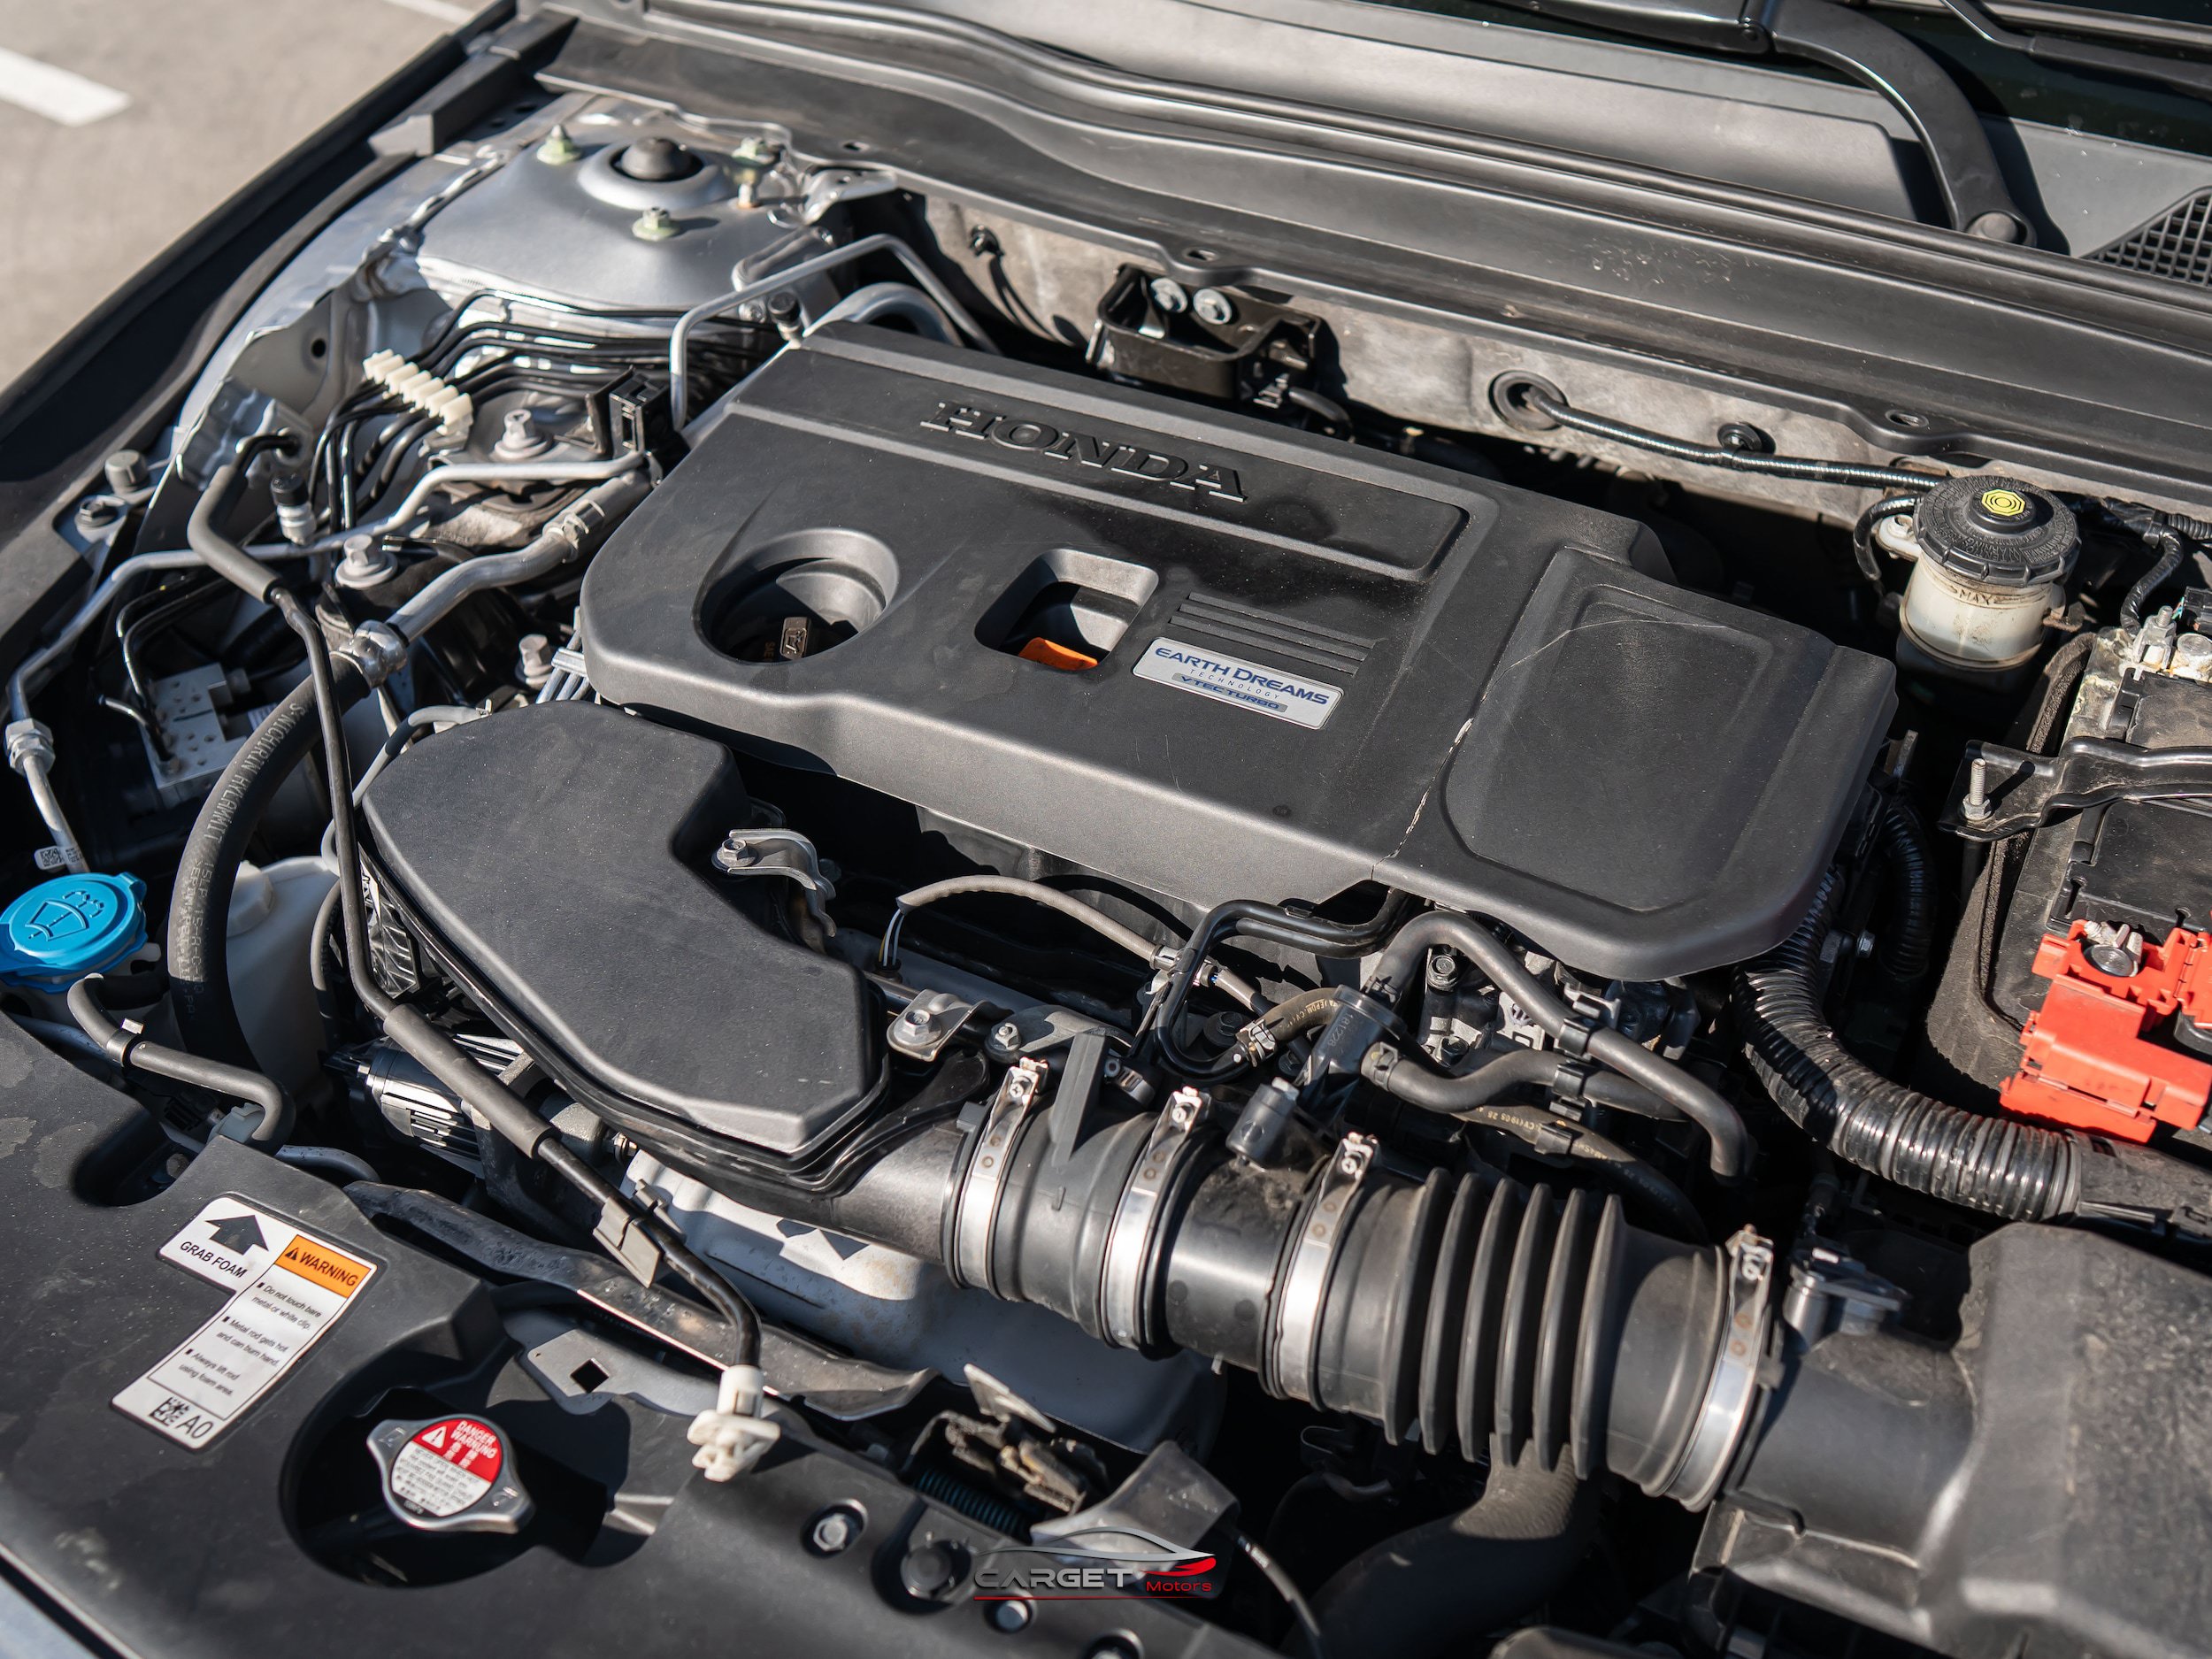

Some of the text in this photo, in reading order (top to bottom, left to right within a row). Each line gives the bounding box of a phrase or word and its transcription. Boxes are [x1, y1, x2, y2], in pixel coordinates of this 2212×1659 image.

[920, 402, 1248, 502] HONDA
[1958, 590, 1992, 606] MAX
[1154, 647, 1330, 706] EARTH DREAMS
[1181, 675, 1280, 710] VTEC TURBO
[1189, 669, 1280, 700] TECHNOLOGY
[180, 1240, 249, 1279] GRAB FOAM
[300, 1251, 359, 1286] WARNING
[263, 1285, 276, 1294] Do
[274, 1291, 288, 1301] not
[457, 1420, 497, 1446] DANGER
